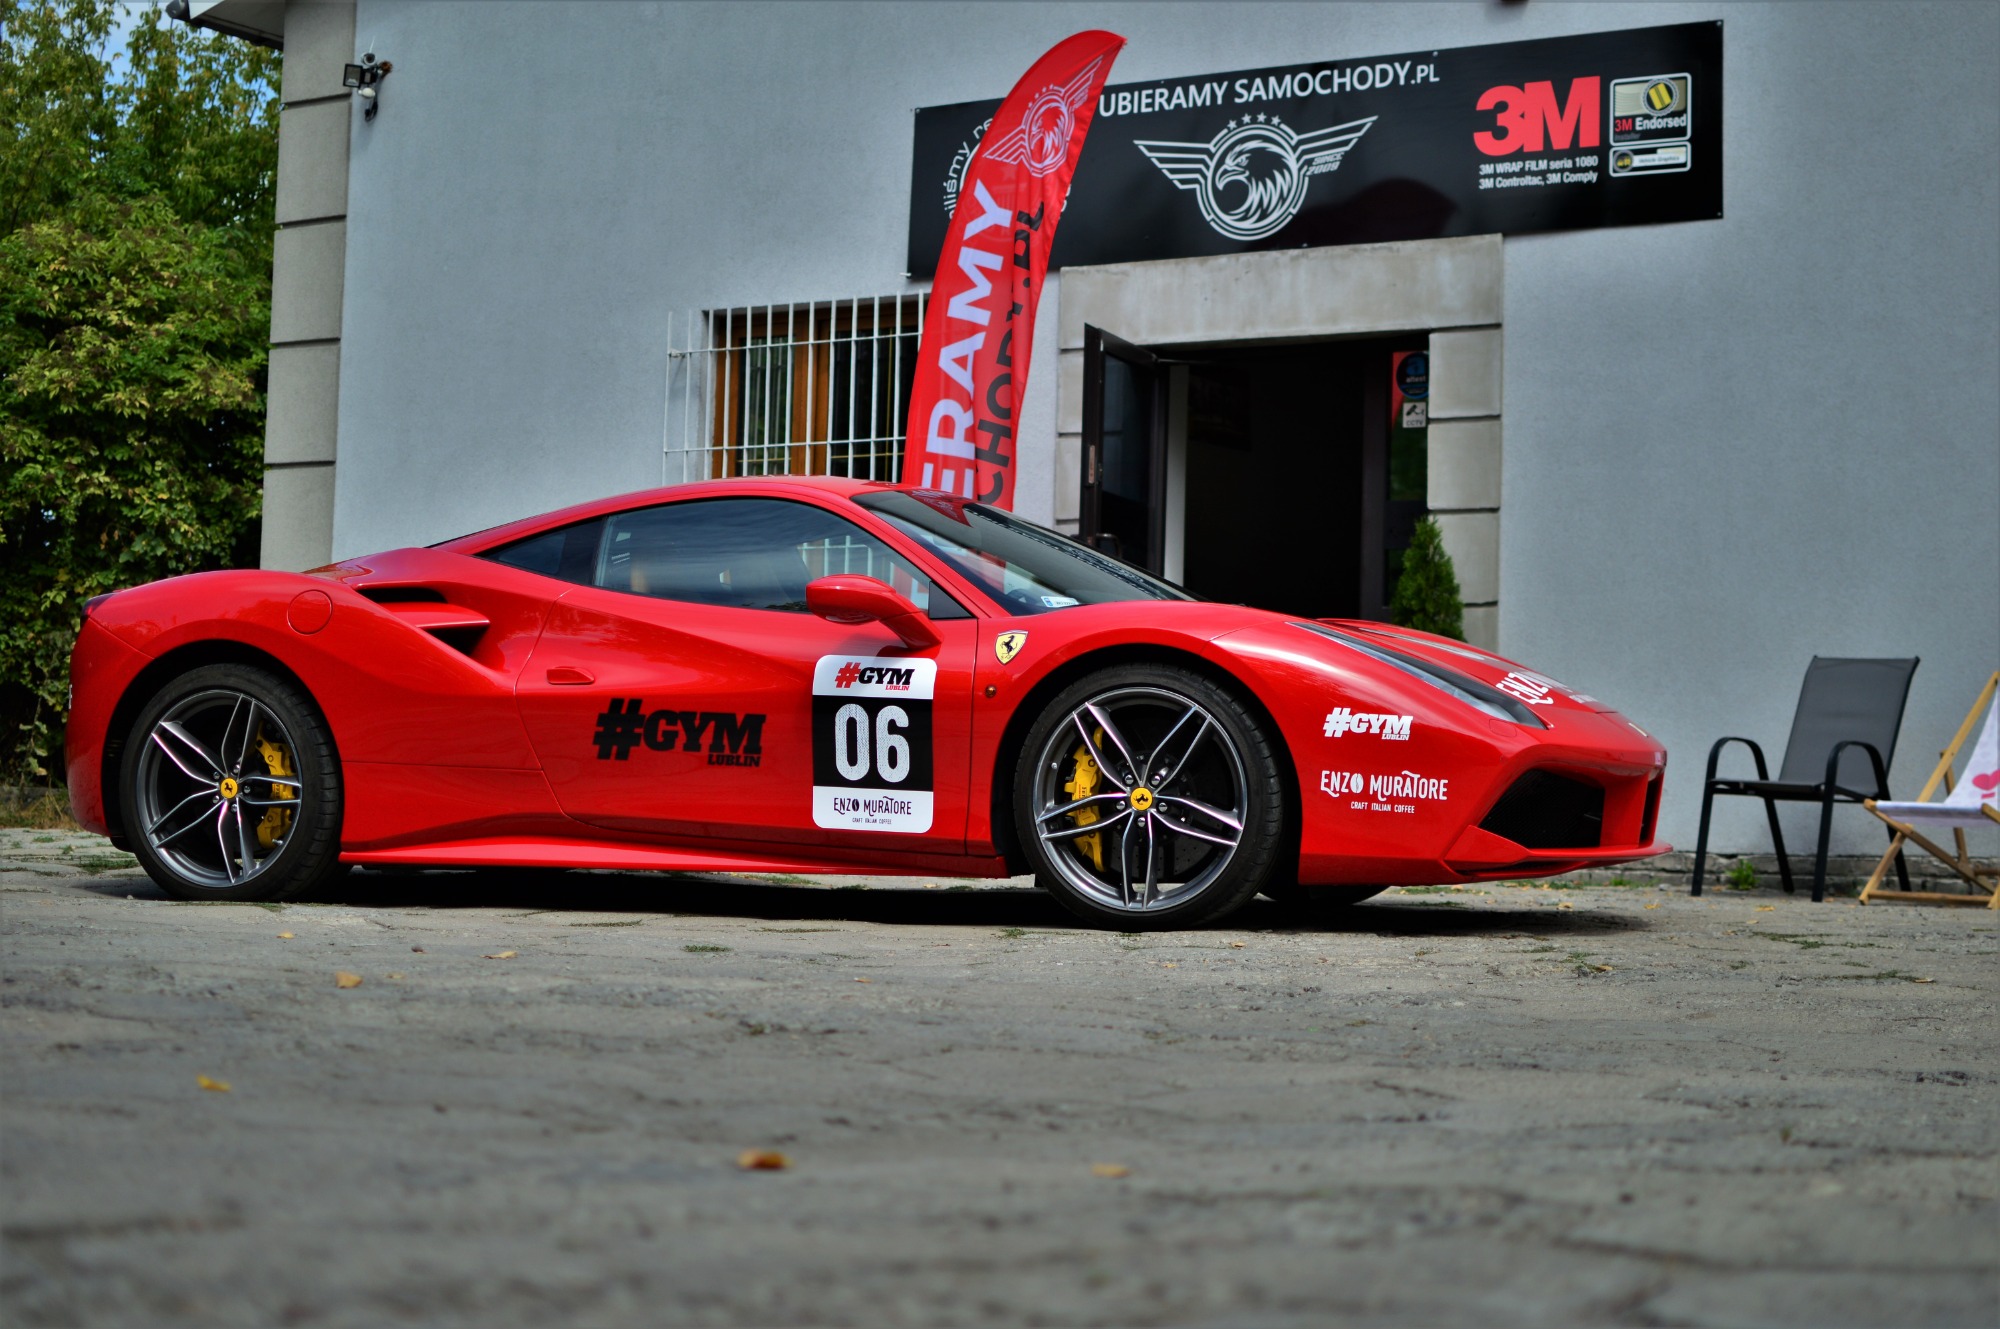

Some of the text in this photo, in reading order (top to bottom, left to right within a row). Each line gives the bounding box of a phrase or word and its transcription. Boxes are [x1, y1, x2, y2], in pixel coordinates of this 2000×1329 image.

[1099, 81, 1229, 117] UBIERAMY
[1234, 60, 1440, 104] SAMOCHODY.PL
[1473, 75, 1601, 157] 3M
[1615, 113, 1687, 132] 3M Endorsed
[1479, 155, 1599, 175] 3M WRAP FILM seria 1080
[1479, 178, 1494, 190] 3M
[1546, 172, 1561, 185] 3M
[1562, 170, 1598, 184] Comply
[834, 662, 916, 689] #GYM
[592, 698, 767, 761] #GYM
[1323, 707, 1414, 738] #GYM
[834, 703, 910, 783] 06
[1381, 733, 1410, 741] LUBLIN
[707, 753, 761, 768] LUBLIN
[1320, 770, 1449, 802] ENZO MURATORE
[833, 796, 912, 817] ENZO MURATORE
[1350, 801, 1415, 814] CRAFT ITALIAN COFFEE
